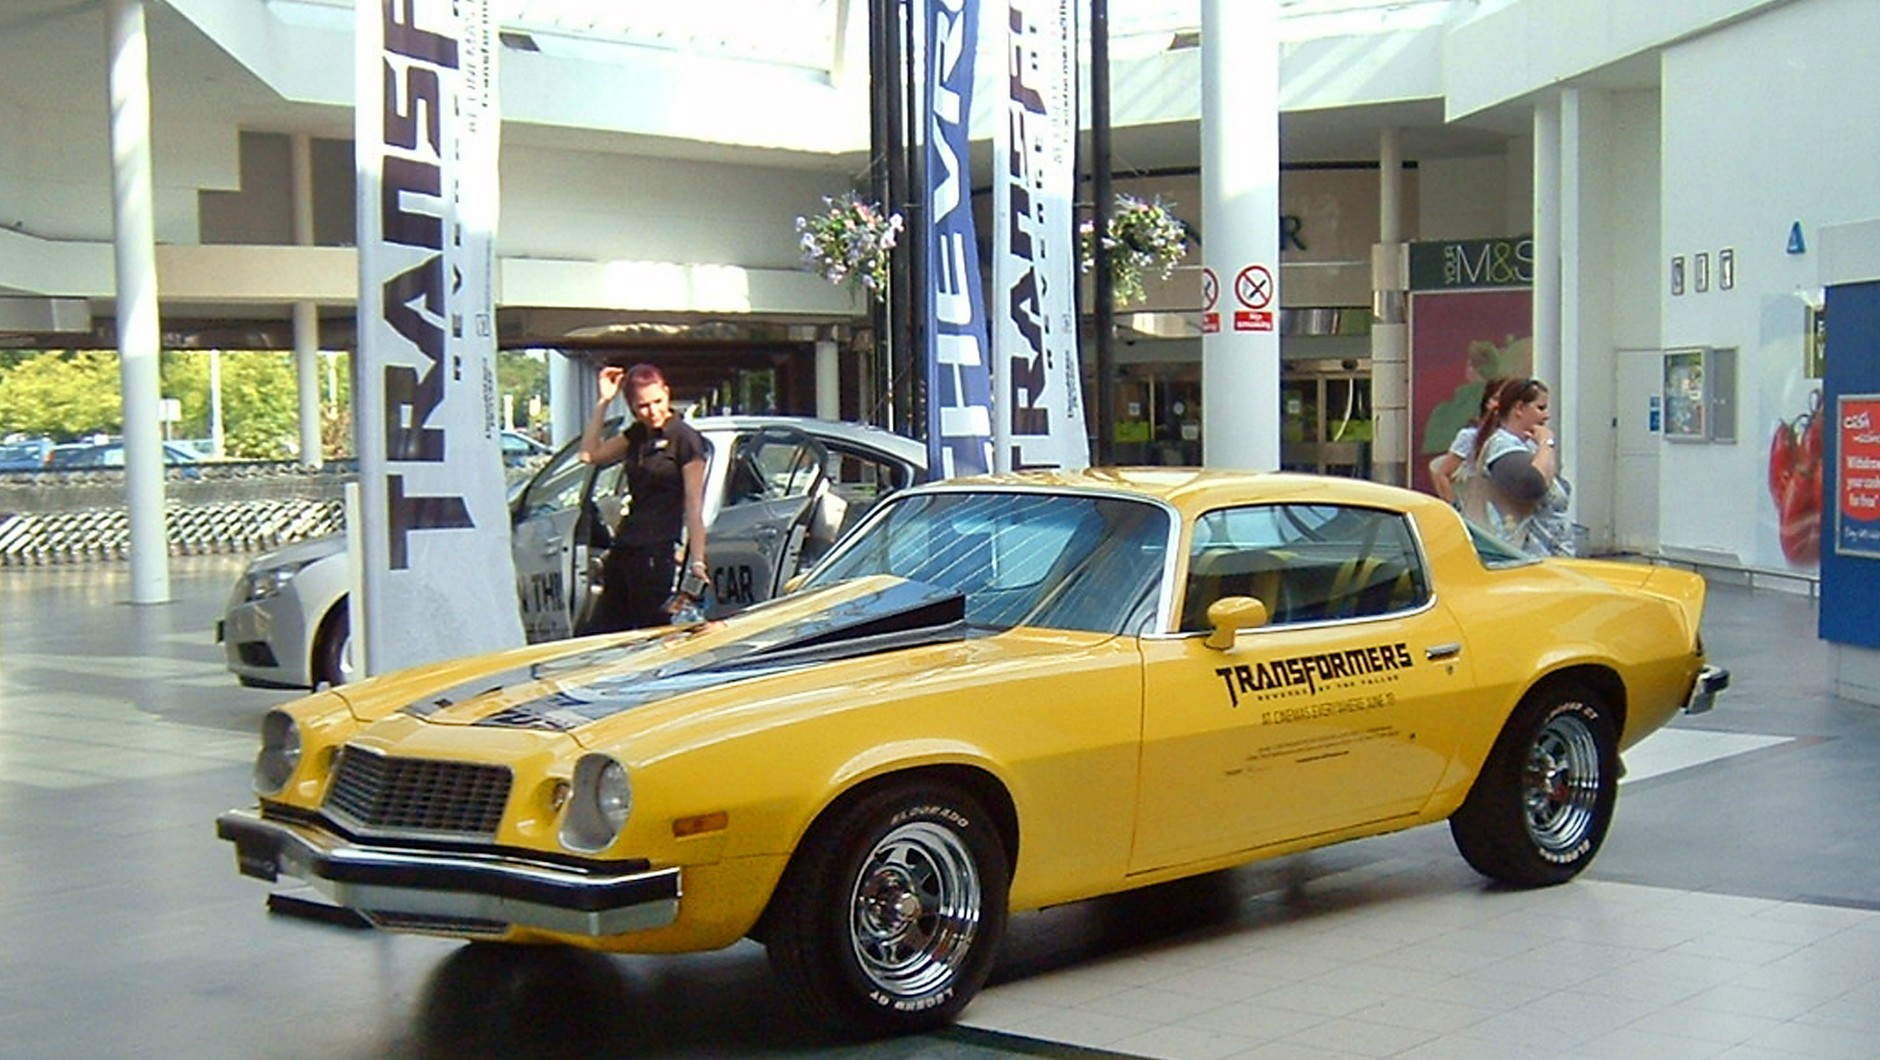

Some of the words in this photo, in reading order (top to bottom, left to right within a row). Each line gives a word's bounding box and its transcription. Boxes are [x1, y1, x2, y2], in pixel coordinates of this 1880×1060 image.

[932, 0, 996, 480] HEVR
[1008, 0, 1061, 472] RANSF
[1457, 240, 1533, 284] M&S
[713, 565, 755, 605] CAR
[1215, 642, 1414, 708] TRANSFORMERS
